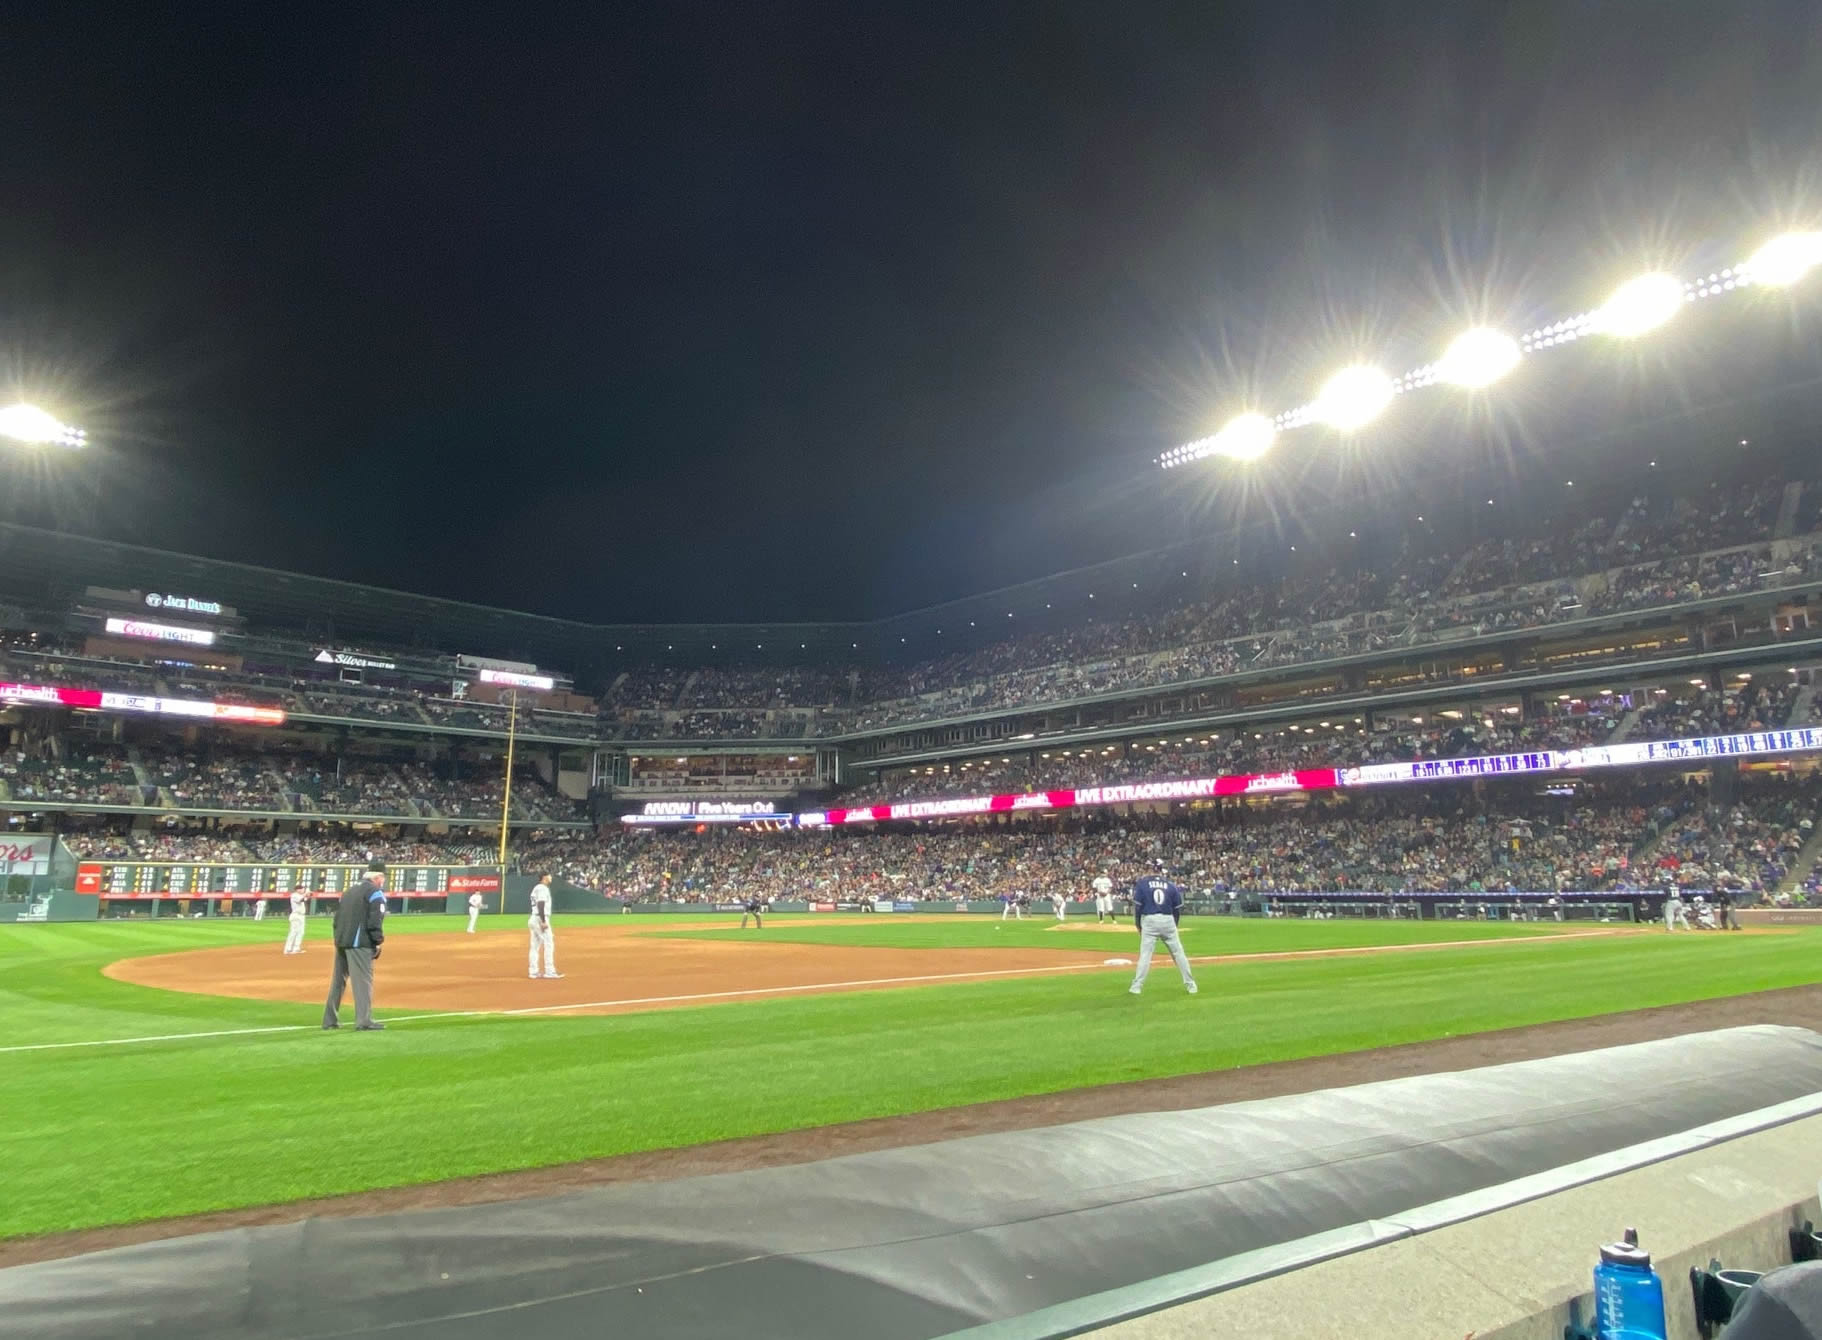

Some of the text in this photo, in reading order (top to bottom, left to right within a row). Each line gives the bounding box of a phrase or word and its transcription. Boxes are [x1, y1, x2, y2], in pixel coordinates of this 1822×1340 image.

[1074, 778, 1217, 804] LIVE EXTRAORDINARY
[722, 802, 752, 814] Years
[753, 801, 774, 814] Out
[890, 797, 992, 819] LIVE EXTRAORDINARY
[1153, 889, 1165, 905] 0
